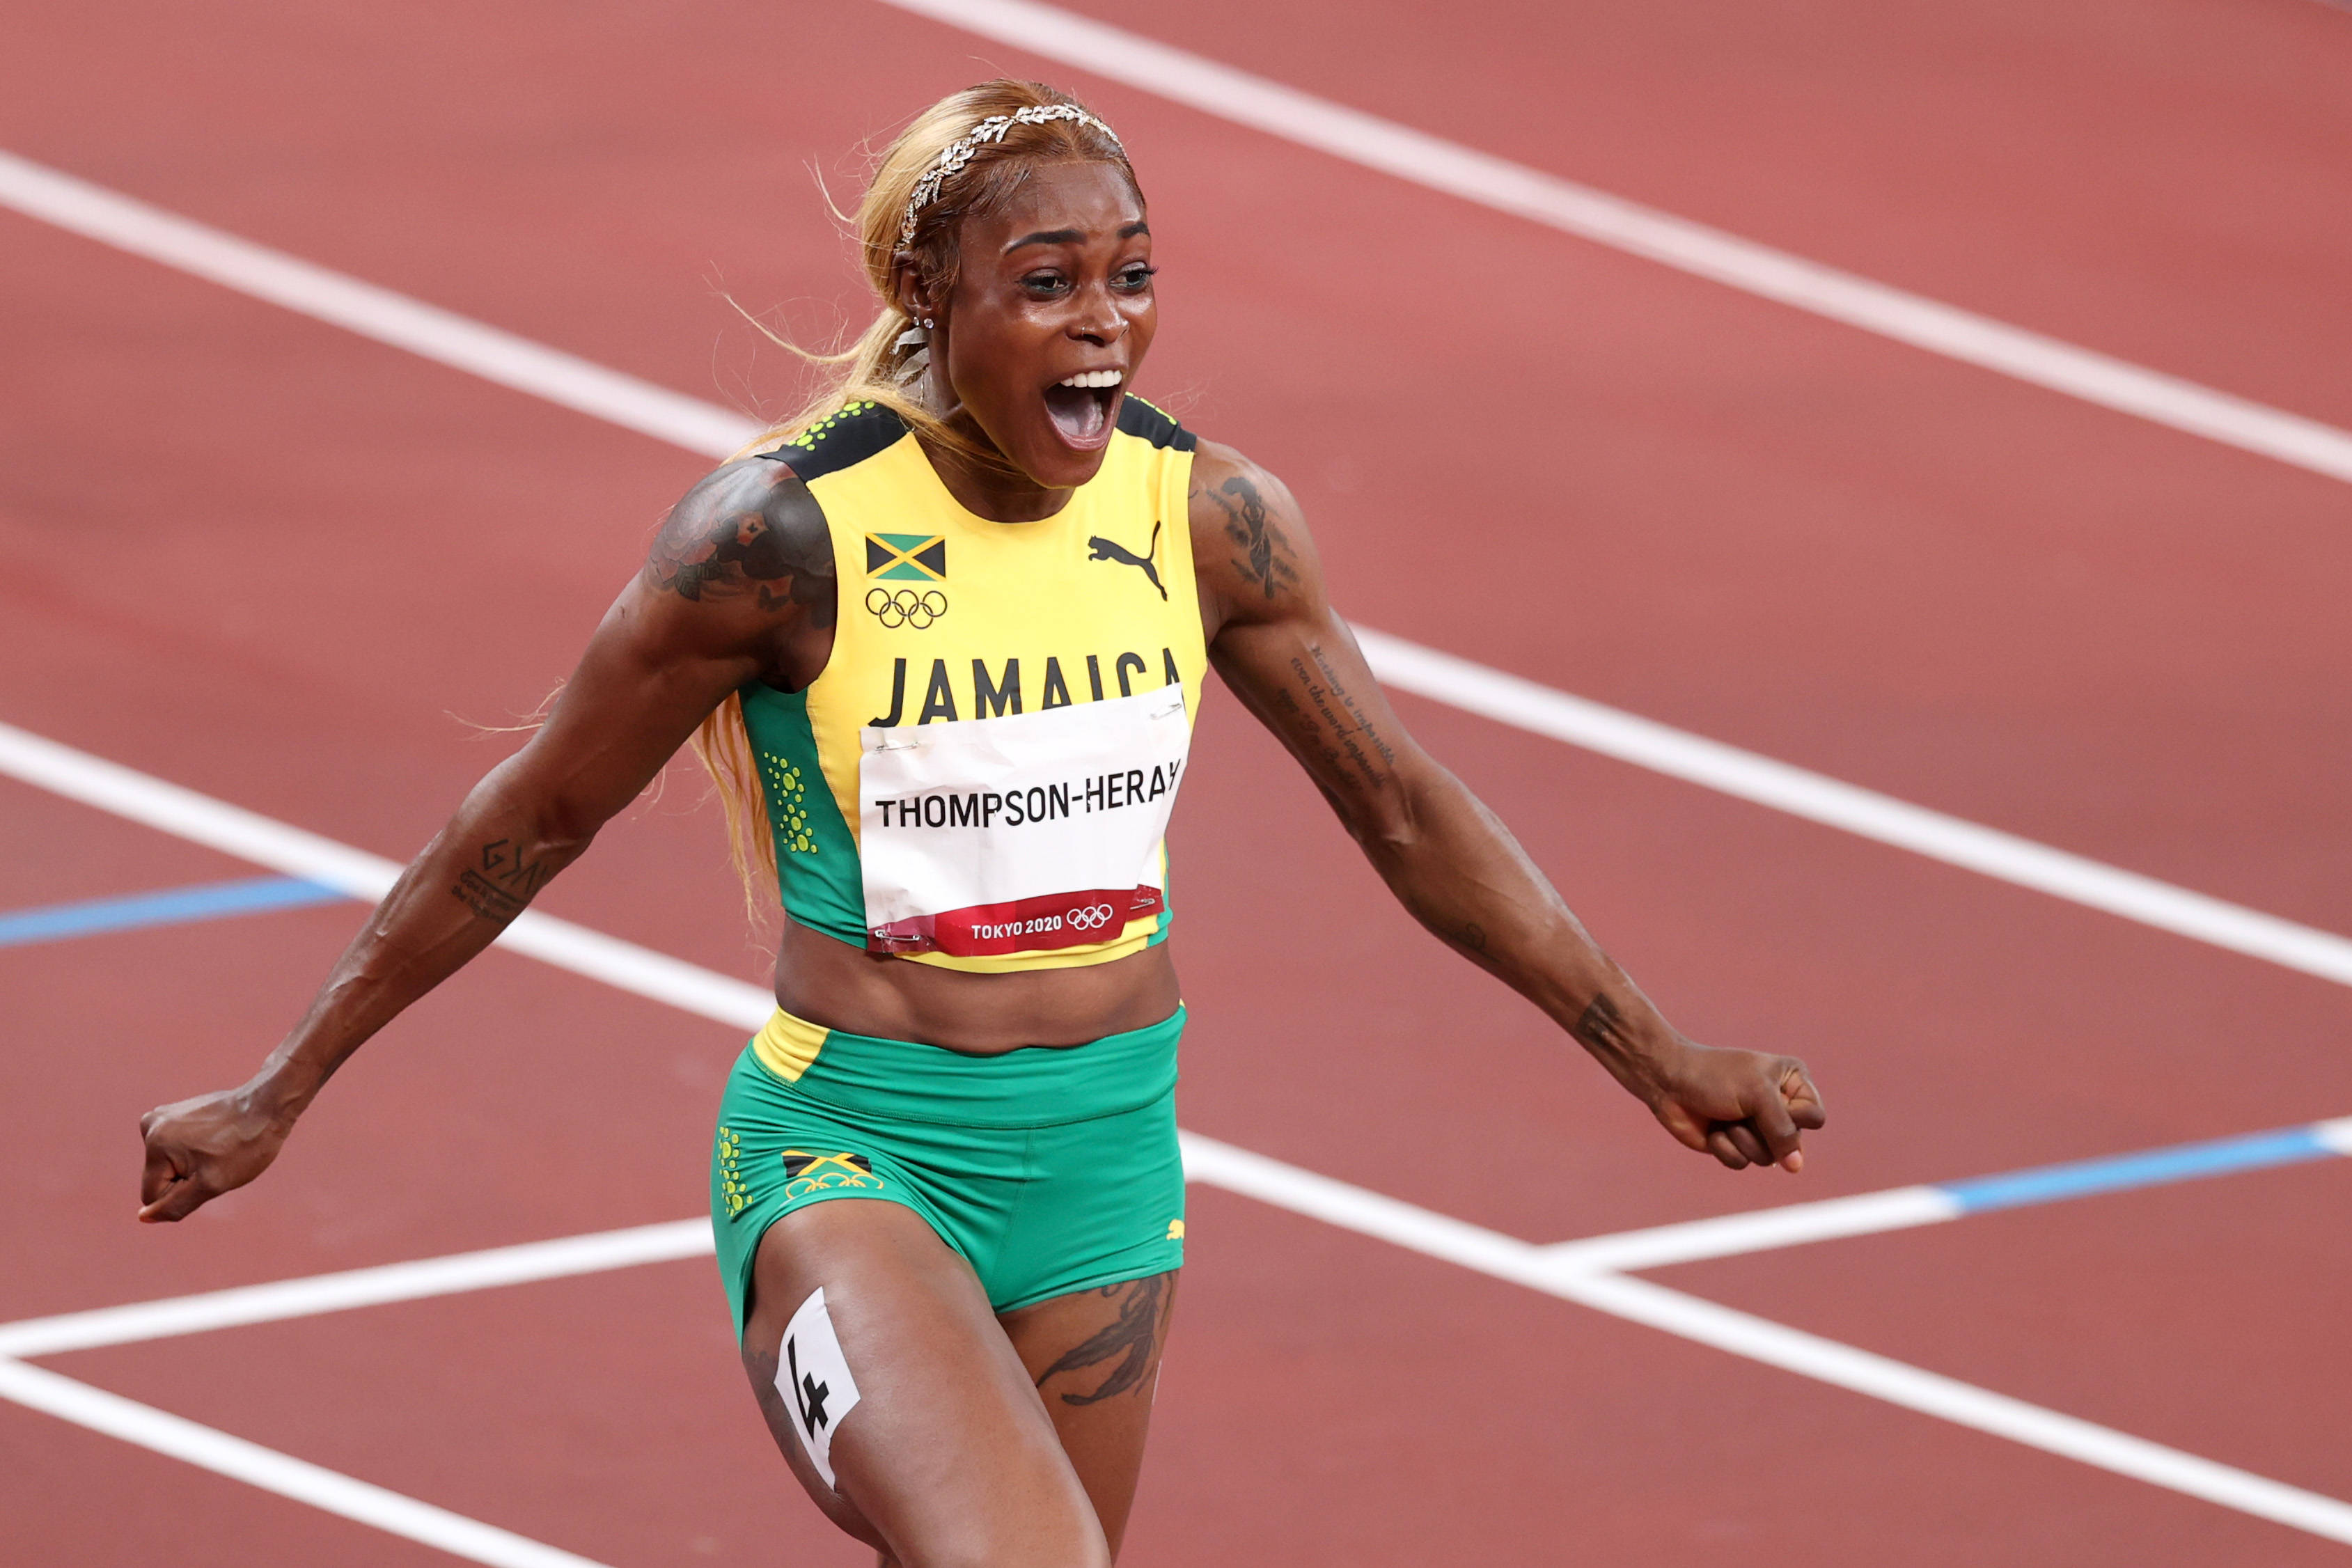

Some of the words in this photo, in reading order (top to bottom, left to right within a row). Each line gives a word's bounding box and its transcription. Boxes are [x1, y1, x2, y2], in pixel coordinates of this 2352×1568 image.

[971, 921, 1022, 939] TOKYO
[1025, 915, 1063, 934] 2020
[787, 1333, 829, 1443] 4
